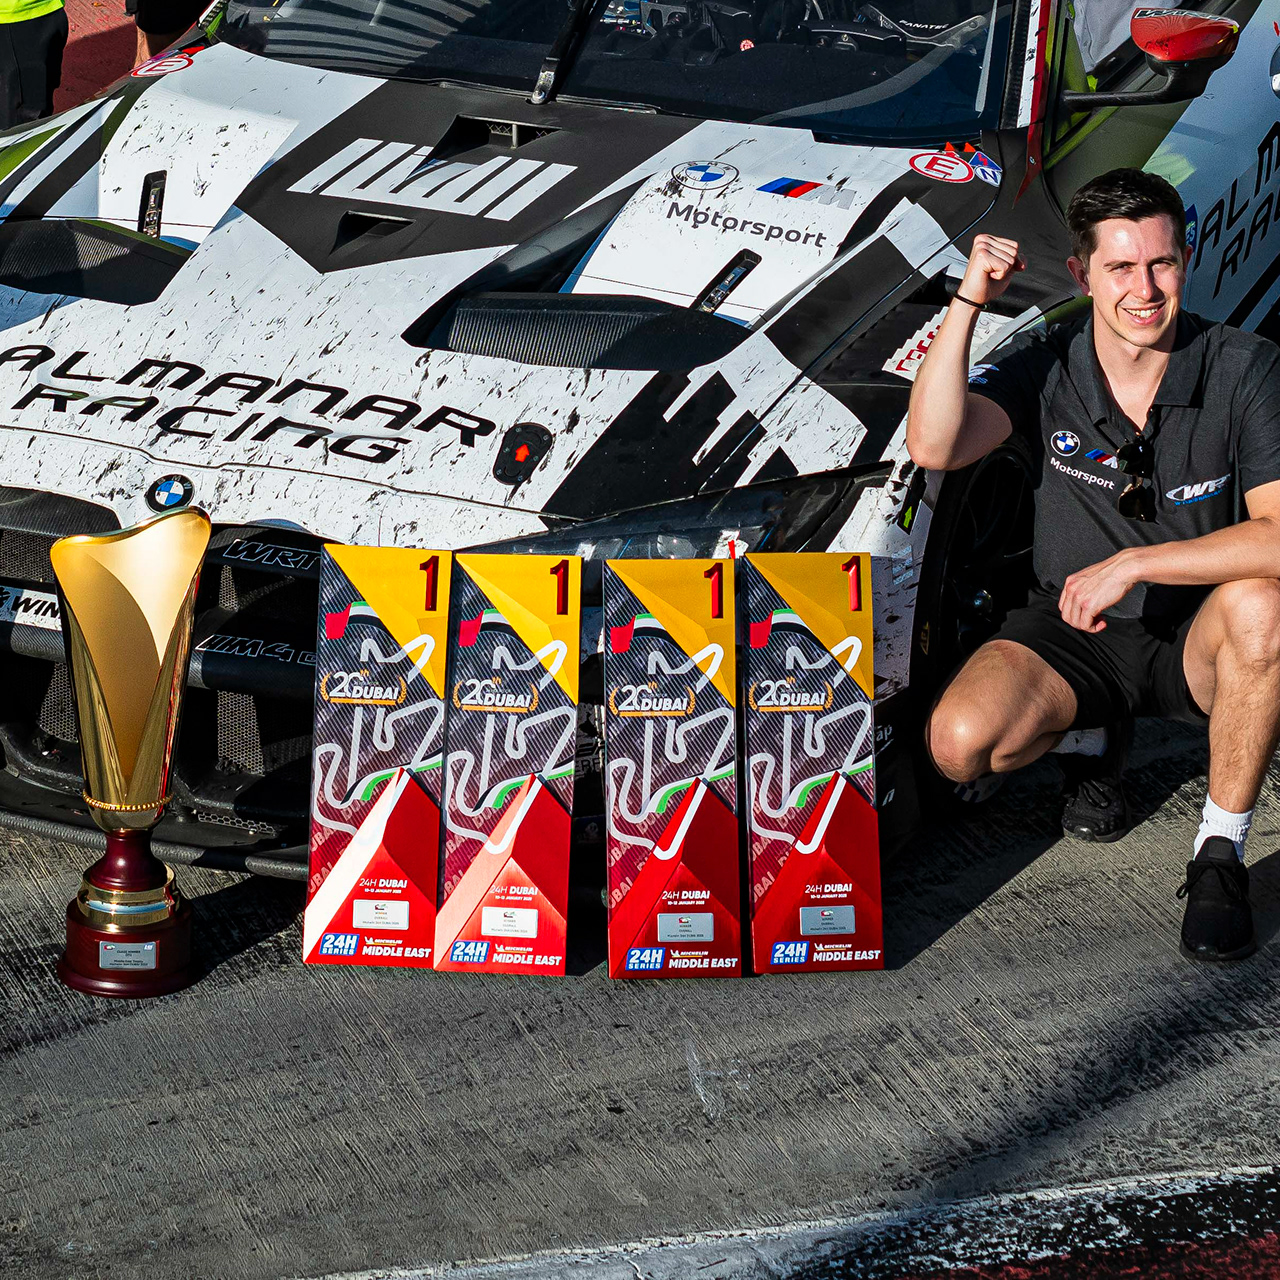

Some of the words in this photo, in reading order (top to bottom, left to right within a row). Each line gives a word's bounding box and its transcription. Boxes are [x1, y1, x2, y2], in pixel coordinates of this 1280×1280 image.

[666, 200, 828, 249] Motorsport
[11, 383, 414, 464] RACING
[1050, 456, 1116, 491] Motorsport
[222, 538, 322, 571] WRT
[419, 554, 440, 612] 1
[549, 558, 570, 616] 1
[841, 555, 863, 612] 1
[703, 562, 724, 620] 1
[351, 685, 399, 701] DUBAI
[483, 692, 532, 708] DUBAI
[779, 692, 826, 707] DUBAI
[639, 696, 689, 711] DUBAI
[358, 878, 378, 887] 24H
[378, 878, 408, 888] DUBAI
[804, 884, 824, 894] 24H
[824, 883, 853, 893] DUBAI
[488, 885, 508, 894] 24H
[508, 886, 538, 896] DUBAI
[661, 890, 680, 900] 24H
[680, 890, 711, 900] DUBAI
[322, 934, 359, 948] 24H
[321, 947, 356, 955] SERIES
[361, 946, 404, 958] MIDDLE
[404, 947, 432, 958] EAST
[453, 942, 489, 956] 24H
[628, 949, 665, 963] 24H
[774, 942, 808, 957] 24H
[812, 951, 855, 962] MIDDLE
[854, 950, 881, 961] EAST
[452, 954, 486, 962] SERIES
[492, 952, 534, 965] MIDDLE
[534, 955, 562, 966] EAST
[668, 958, 711, 968] MIDDLE
[711, 958, 738, 968] EAST
[773, 956, 806, 964] SERIES
[628, 962, 662, 970] SERIES
